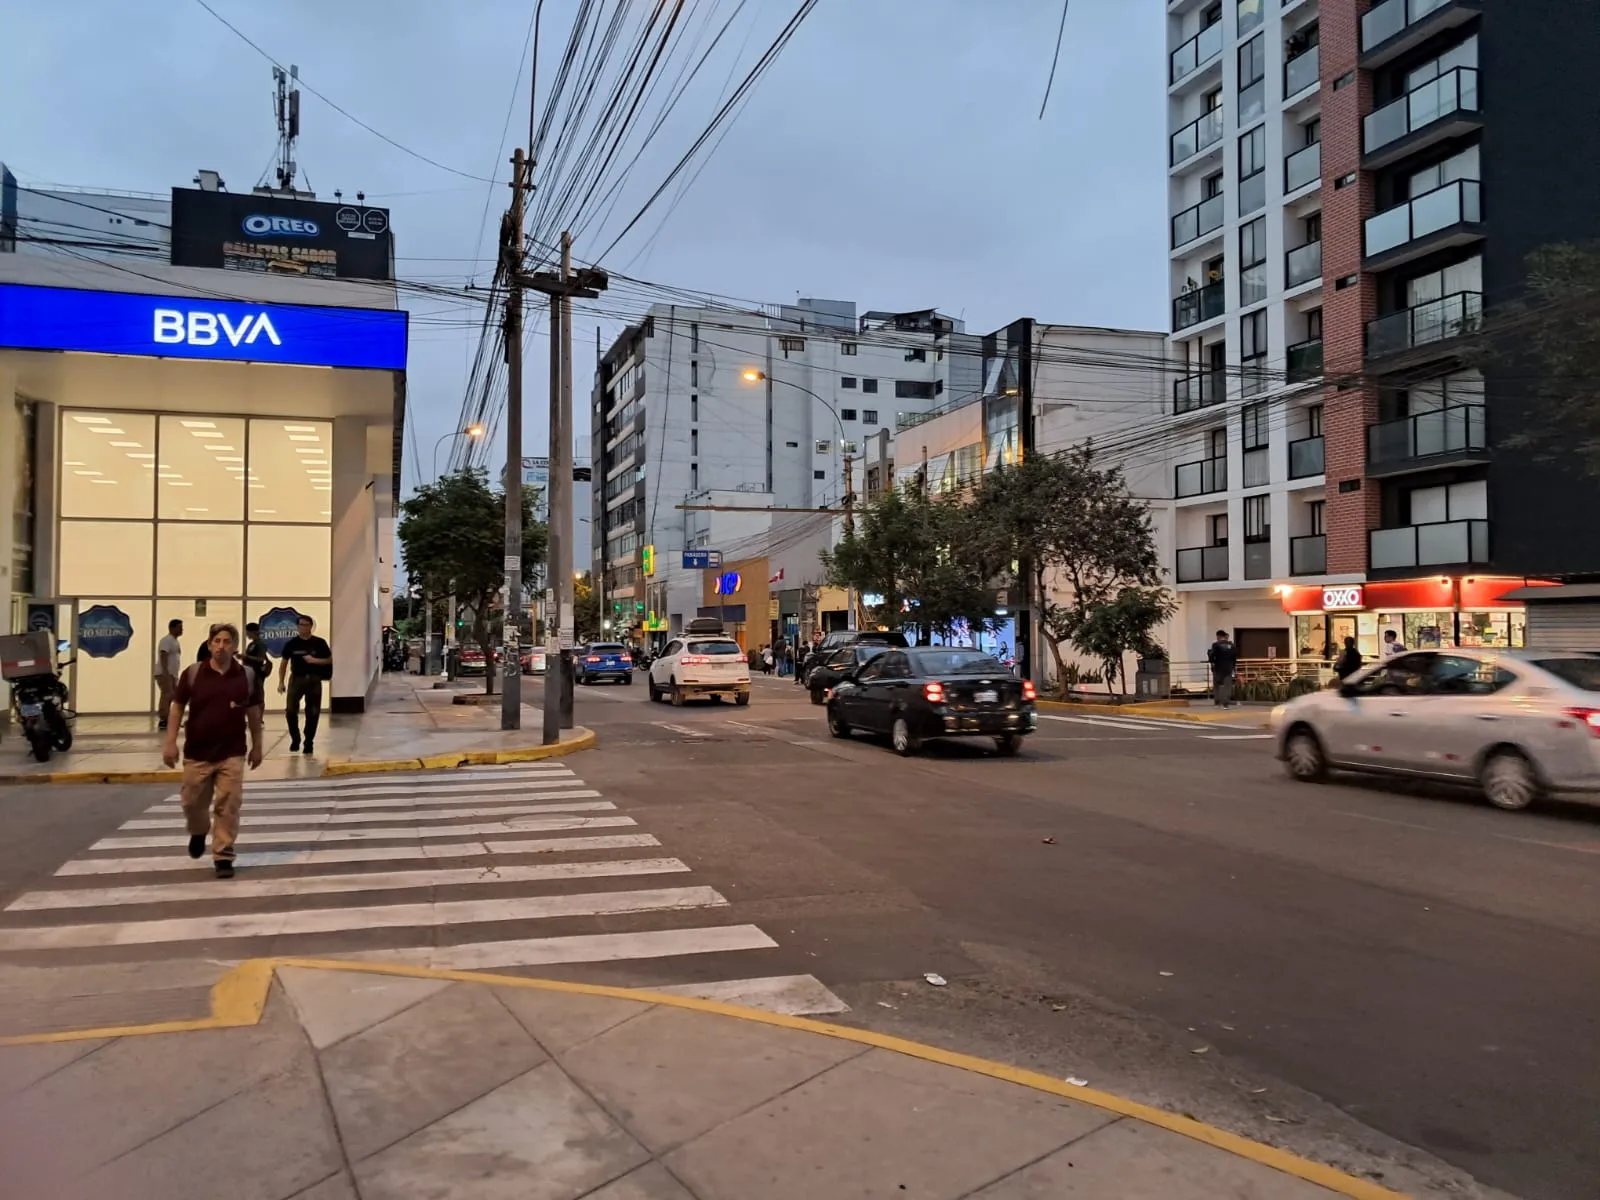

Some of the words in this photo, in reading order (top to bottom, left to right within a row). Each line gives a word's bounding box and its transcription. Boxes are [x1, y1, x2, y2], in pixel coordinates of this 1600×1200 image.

[245, 216, 318, 235] OREO
[153, 307, 282, 347] BBVA
[1323, 590, 1360, 607] OXXO
